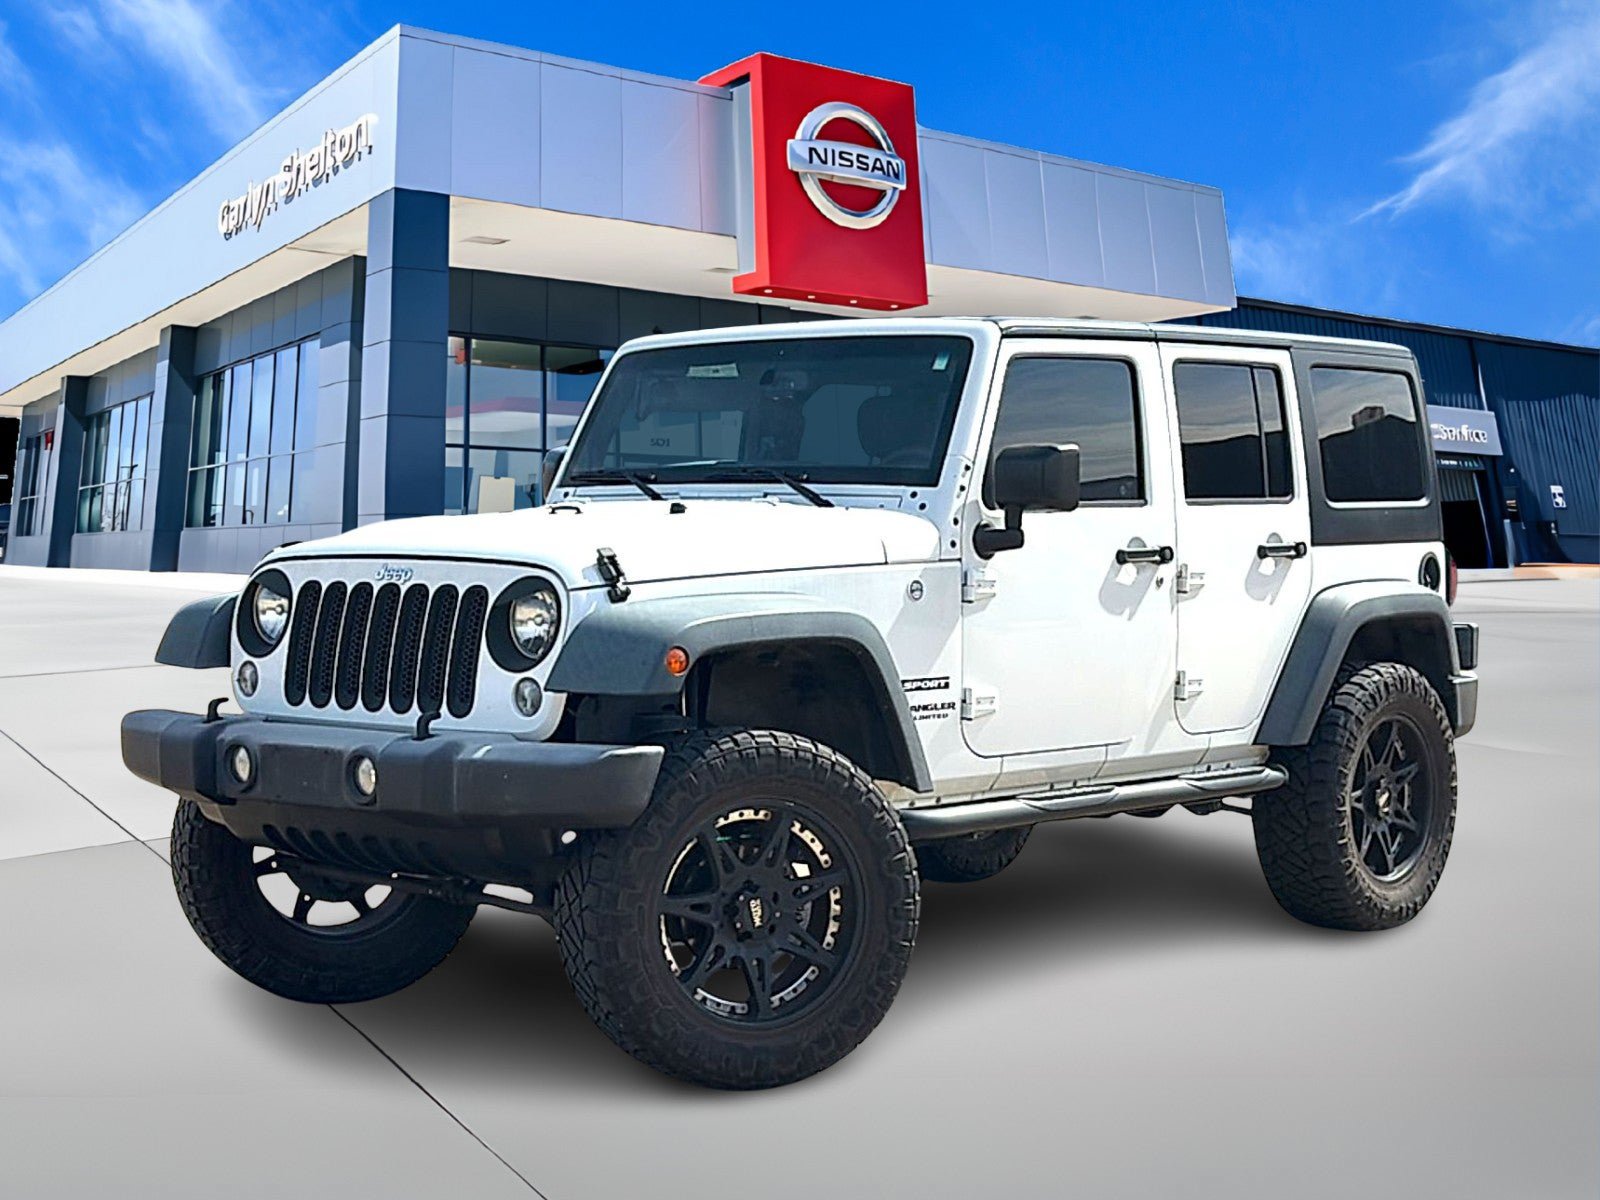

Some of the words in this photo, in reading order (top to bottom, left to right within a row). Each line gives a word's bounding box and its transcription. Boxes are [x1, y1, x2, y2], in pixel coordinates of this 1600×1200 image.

[280, 114, 376, 199] Shelton
[808, 147, 901, 181] NISSAN
[374, 562, 414, 585] Jeep
[902, 678, 948, 691] SPORT
[910, 702, 956, 712] ANGLER
[912, 713, 949, 721] LIMITED
